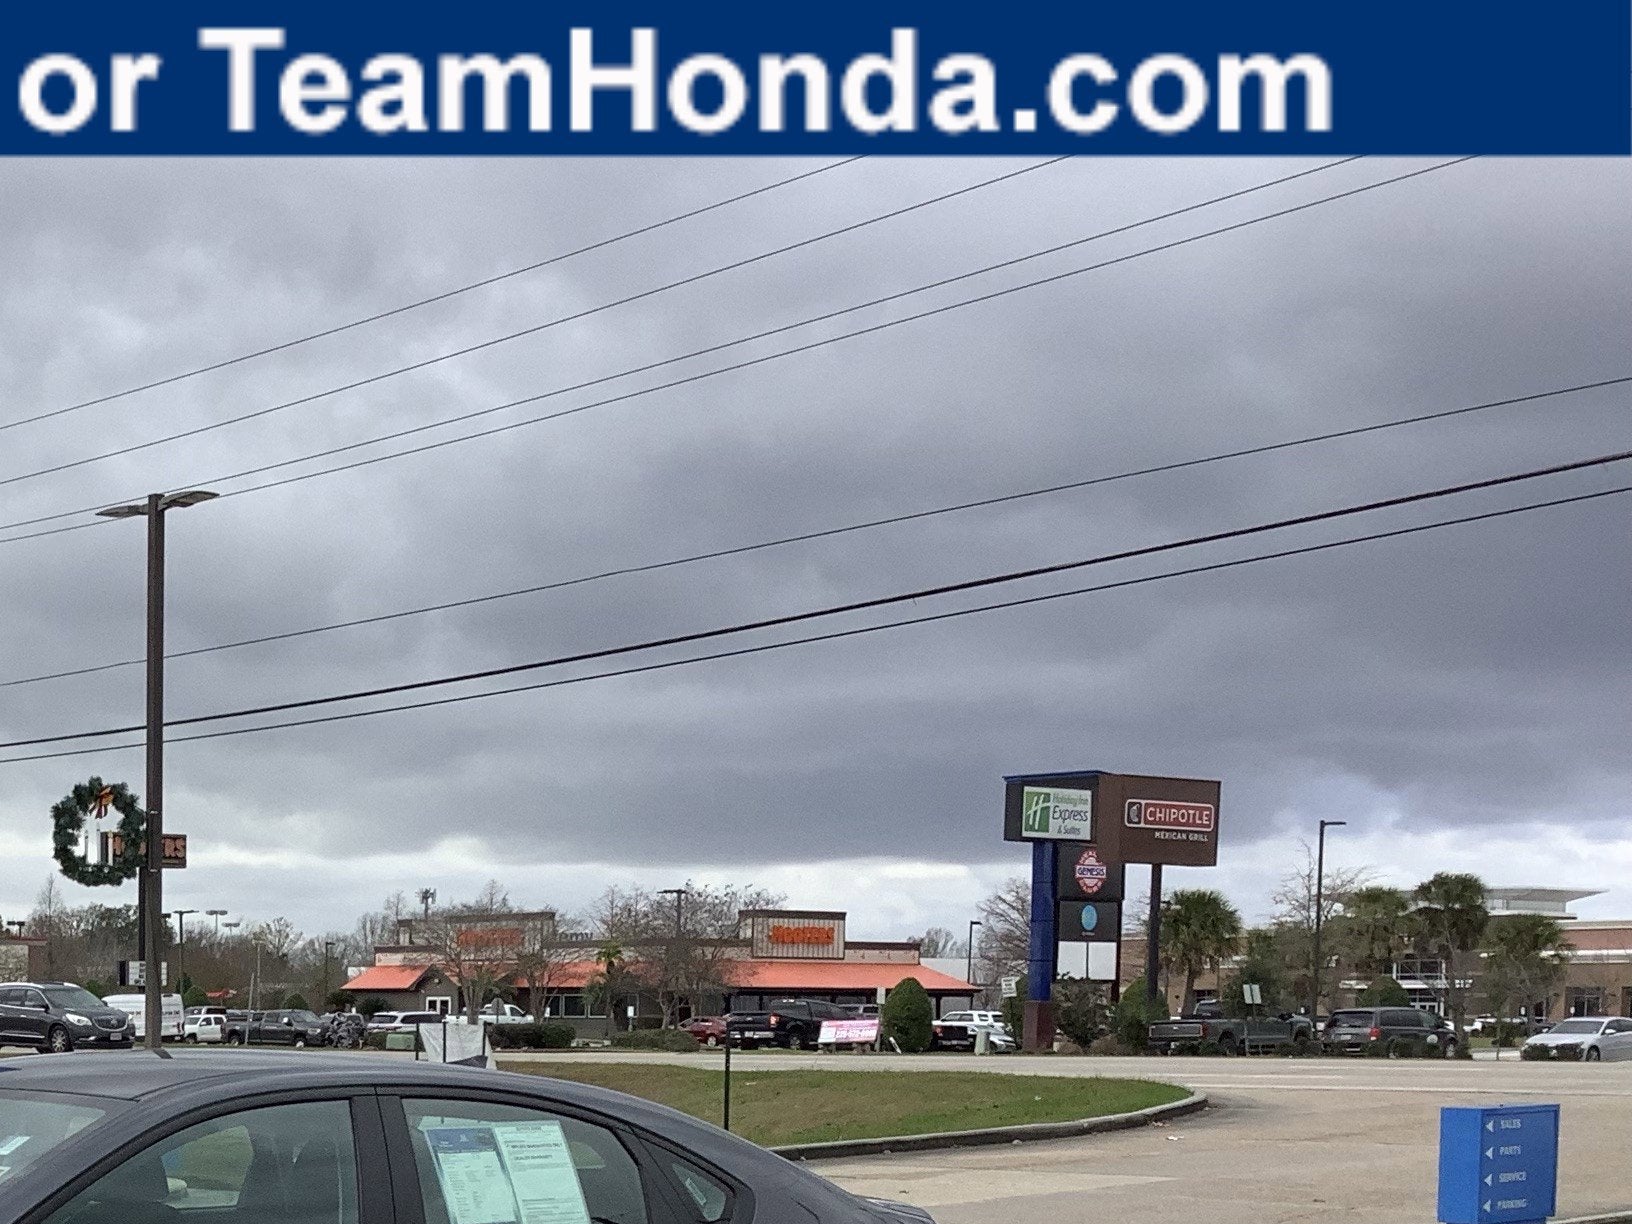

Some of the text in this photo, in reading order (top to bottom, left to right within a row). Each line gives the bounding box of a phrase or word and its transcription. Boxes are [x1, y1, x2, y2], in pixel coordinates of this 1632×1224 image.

[1052, 805, 1089, 824] Express
[1146, 806, 1210, 825] CHIPOTLE
[1154, 831, 1209, 842] MEXICAN GRILL
[1500, 1118, 1521, 1129] SALES
[1499, 1145, 1521, 1155] PARTS
[1498, 1171, 1526, 1183] SERVICE
[1497, 1198, 1527, 1210] PARKING
